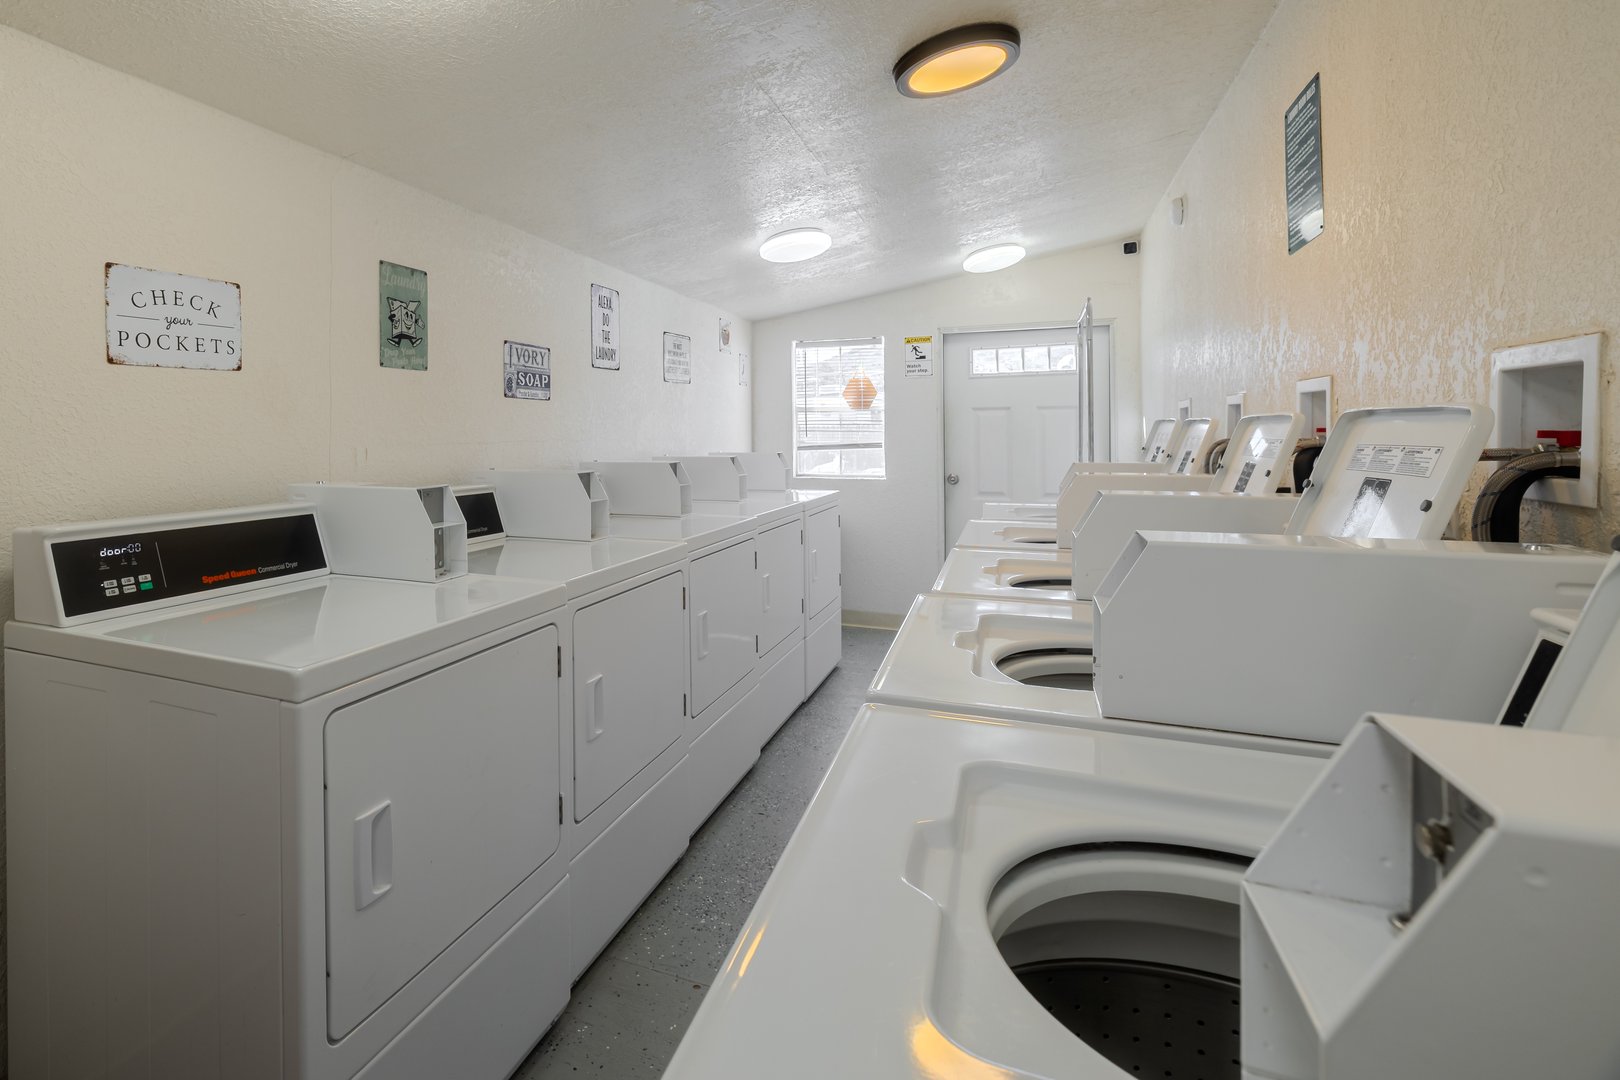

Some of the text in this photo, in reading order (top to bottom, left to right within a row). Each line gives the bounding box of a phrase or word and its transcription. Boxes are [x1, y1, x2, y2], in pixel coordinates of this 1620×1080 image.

[131, 289, 221, 319] CHECK
[164, 316, 193, 330] your
[602, 312, 610, 326] DO
[117, 330, 235, 355] POCKETS
[601, 329, 611, 344] THE
[509, 344, 547, 368] IVORY
[595, 345, 617, 361] LAUNDRY
[517, 372, 549, 388] SOAP
[201, 561, 298, 584] Speed Queen Commercial Dryer
